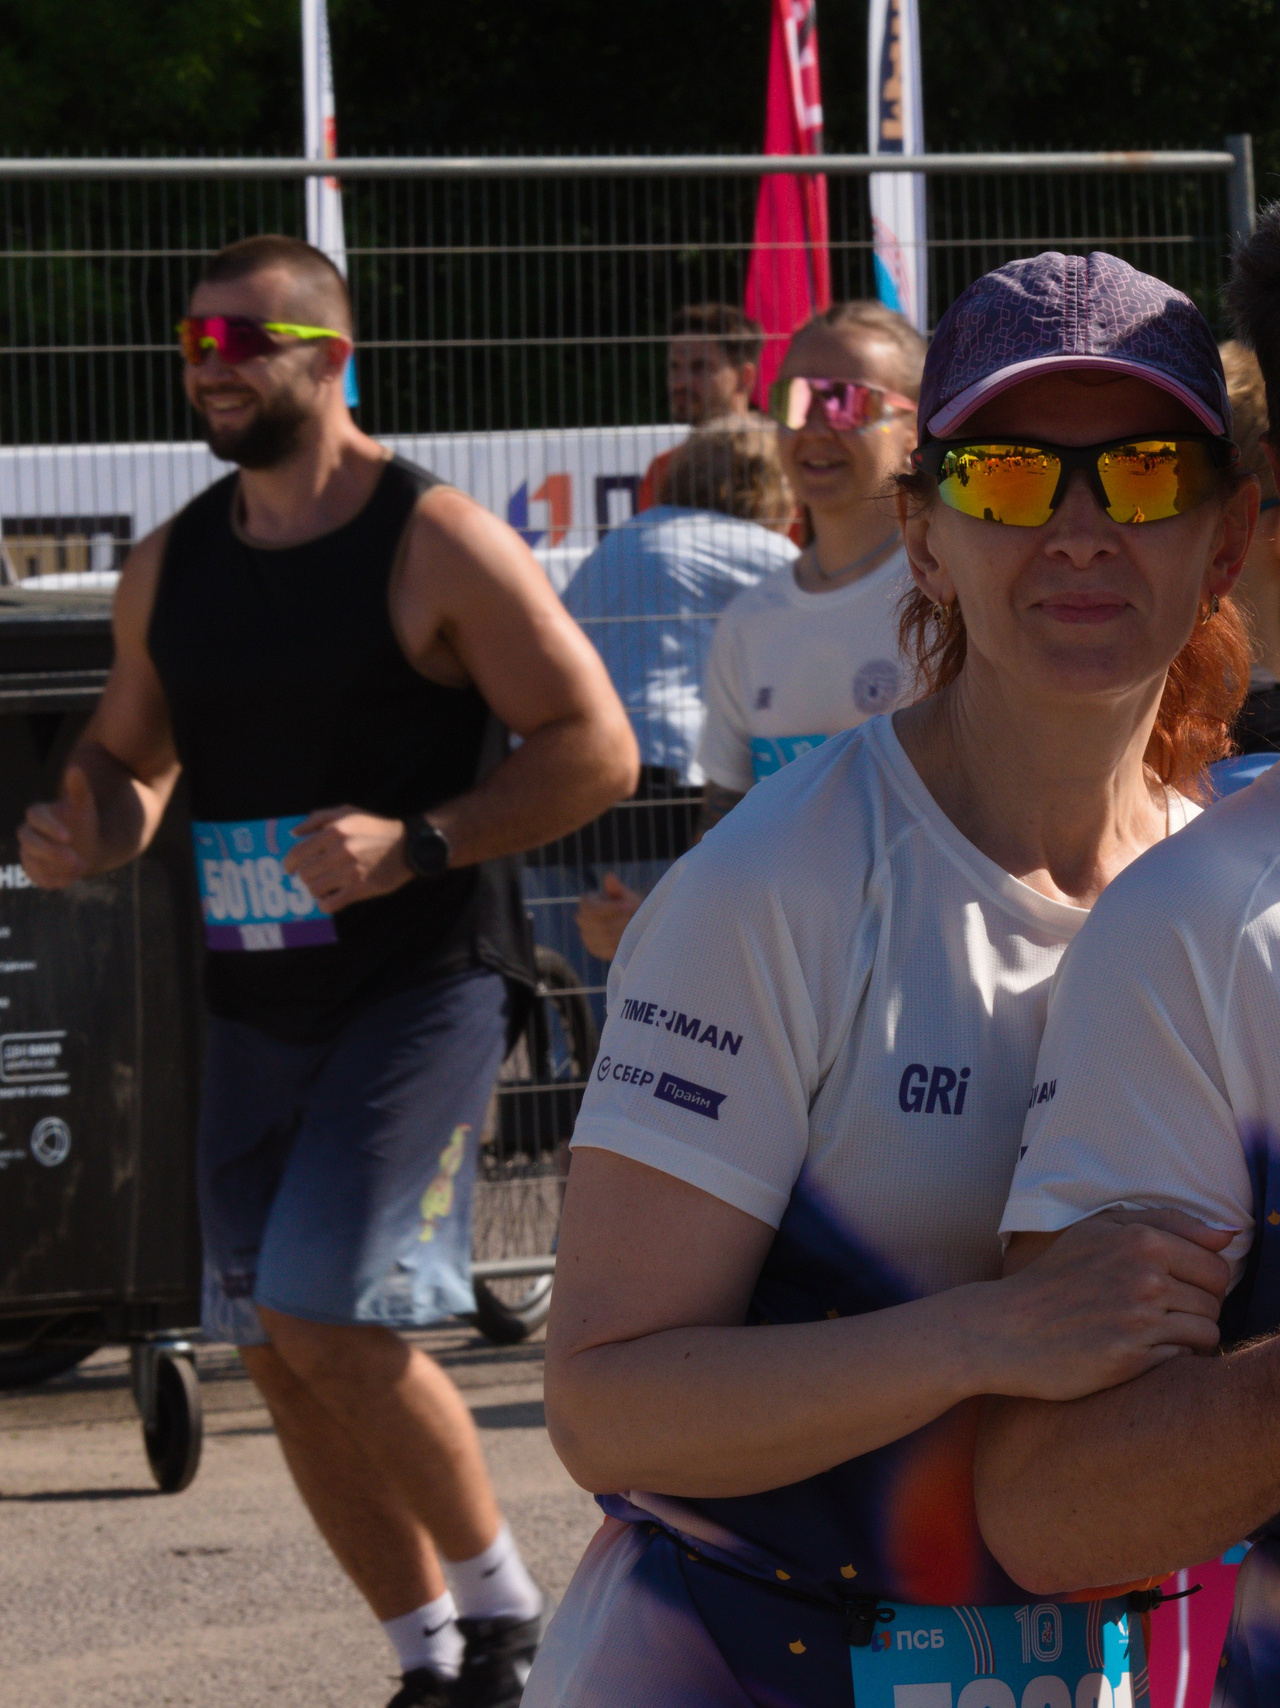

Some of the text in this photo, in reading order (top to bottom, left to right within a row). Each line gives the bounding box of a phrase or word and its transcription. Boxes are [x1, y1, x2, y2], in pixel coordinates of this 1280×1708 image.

[613, 1064, 711, 1108] СБЕР Прайм
[899, 1063, 971, 1115] GRi
[897, 1628, 945, 1650] ПСБ
[1014, 1603, 1062, 1664] 10
